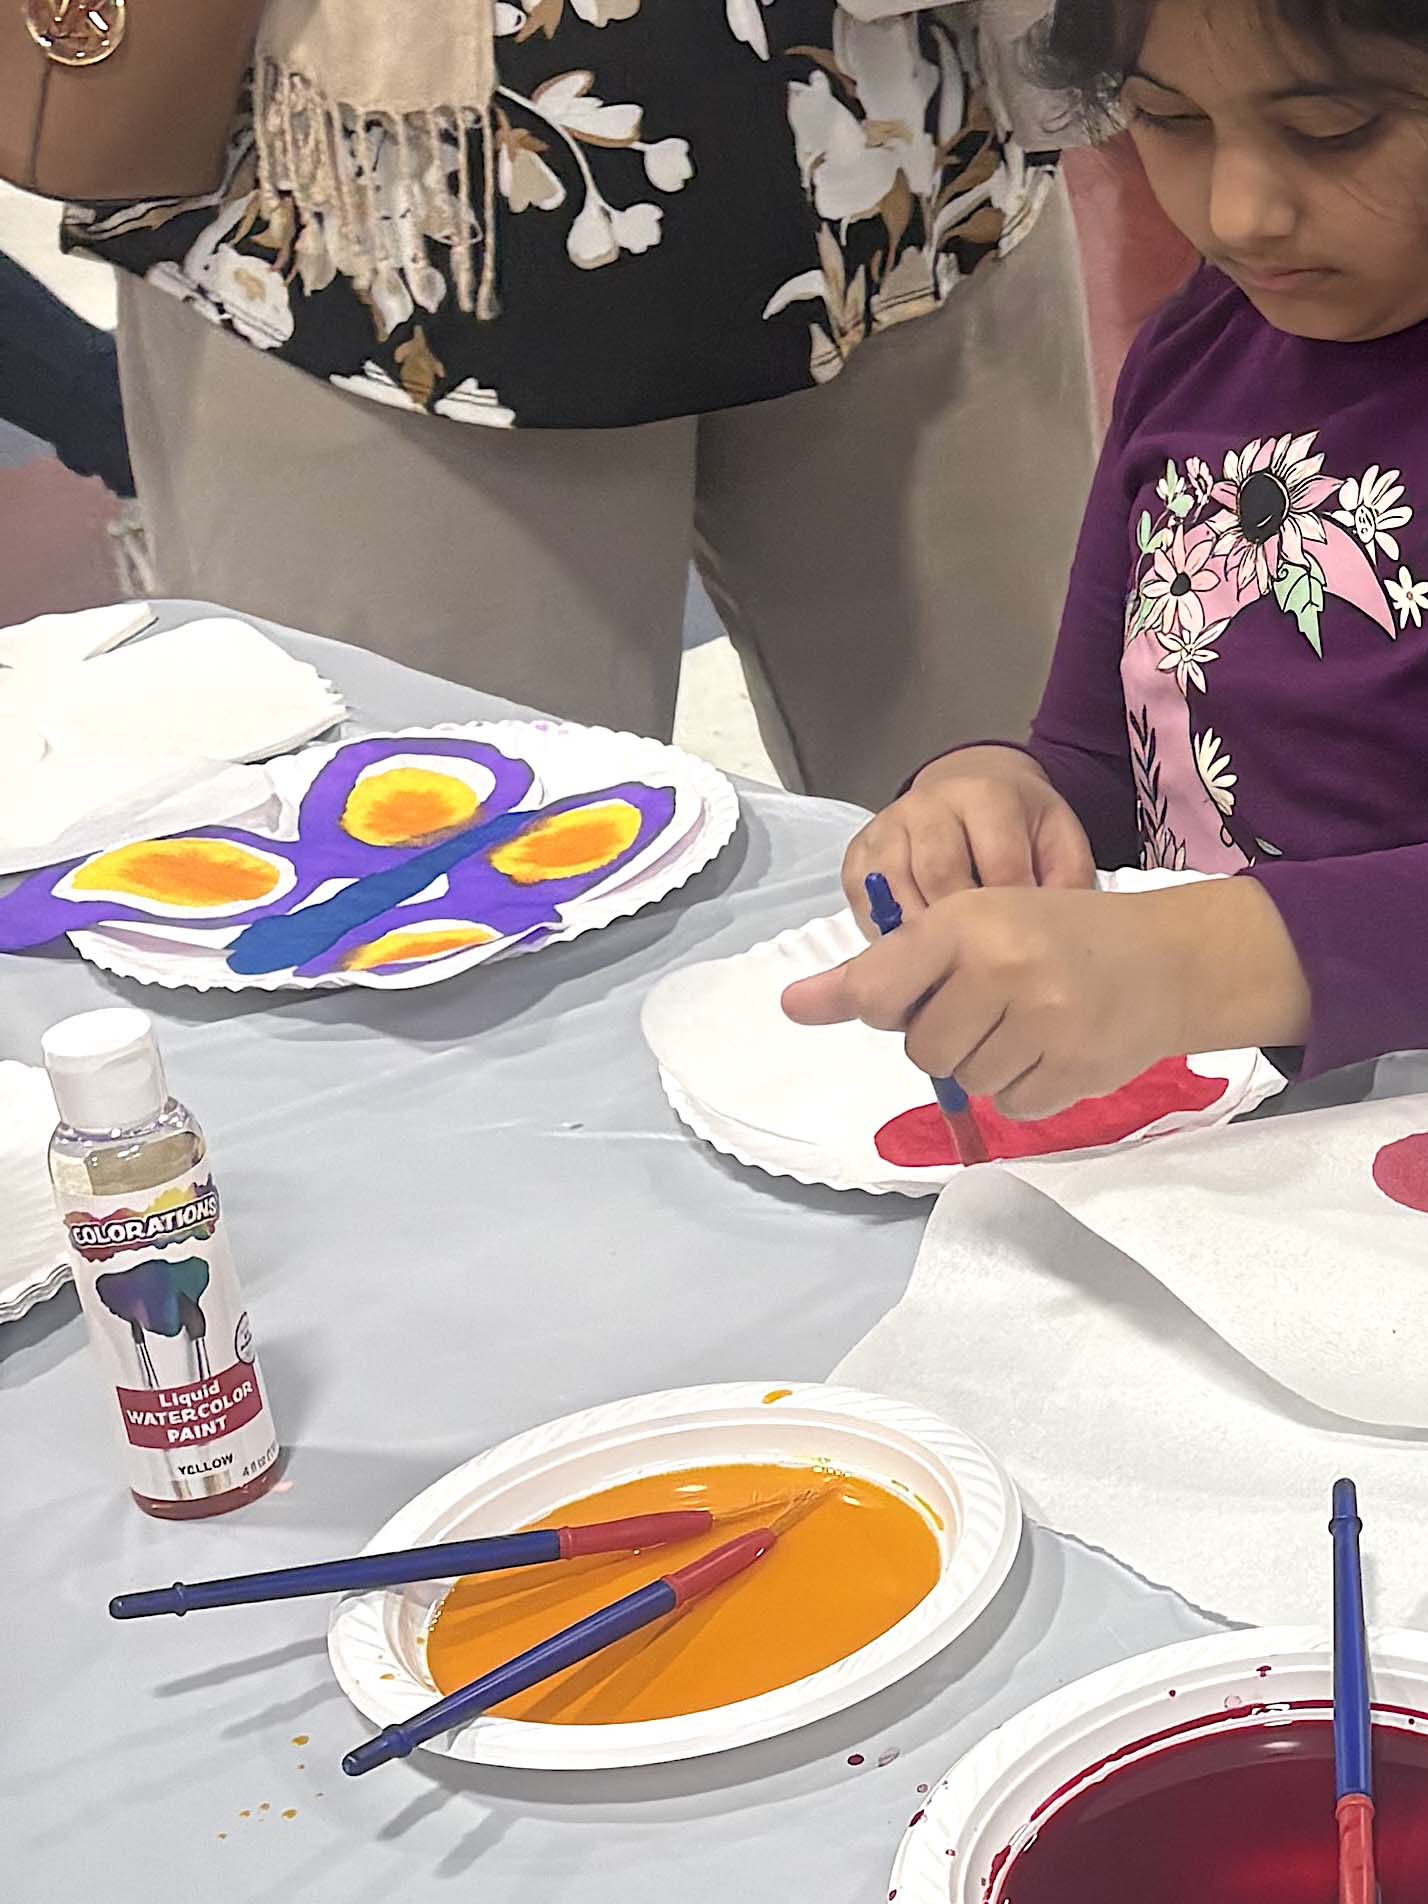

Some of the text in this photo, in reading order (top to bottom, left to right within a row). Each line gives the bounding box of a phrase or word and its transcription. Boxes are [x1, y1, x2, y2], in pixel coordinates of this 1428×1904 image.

[72, 1195, 218, 1245] COLORATIONS
[126, 1380, 253, 1426] WATERCOLOR
[158, 1379, 221, 1408] Liquid
[166, 1414, 227, 1443] PAINT
[178, 1452, 234, 1476] YELLOW
